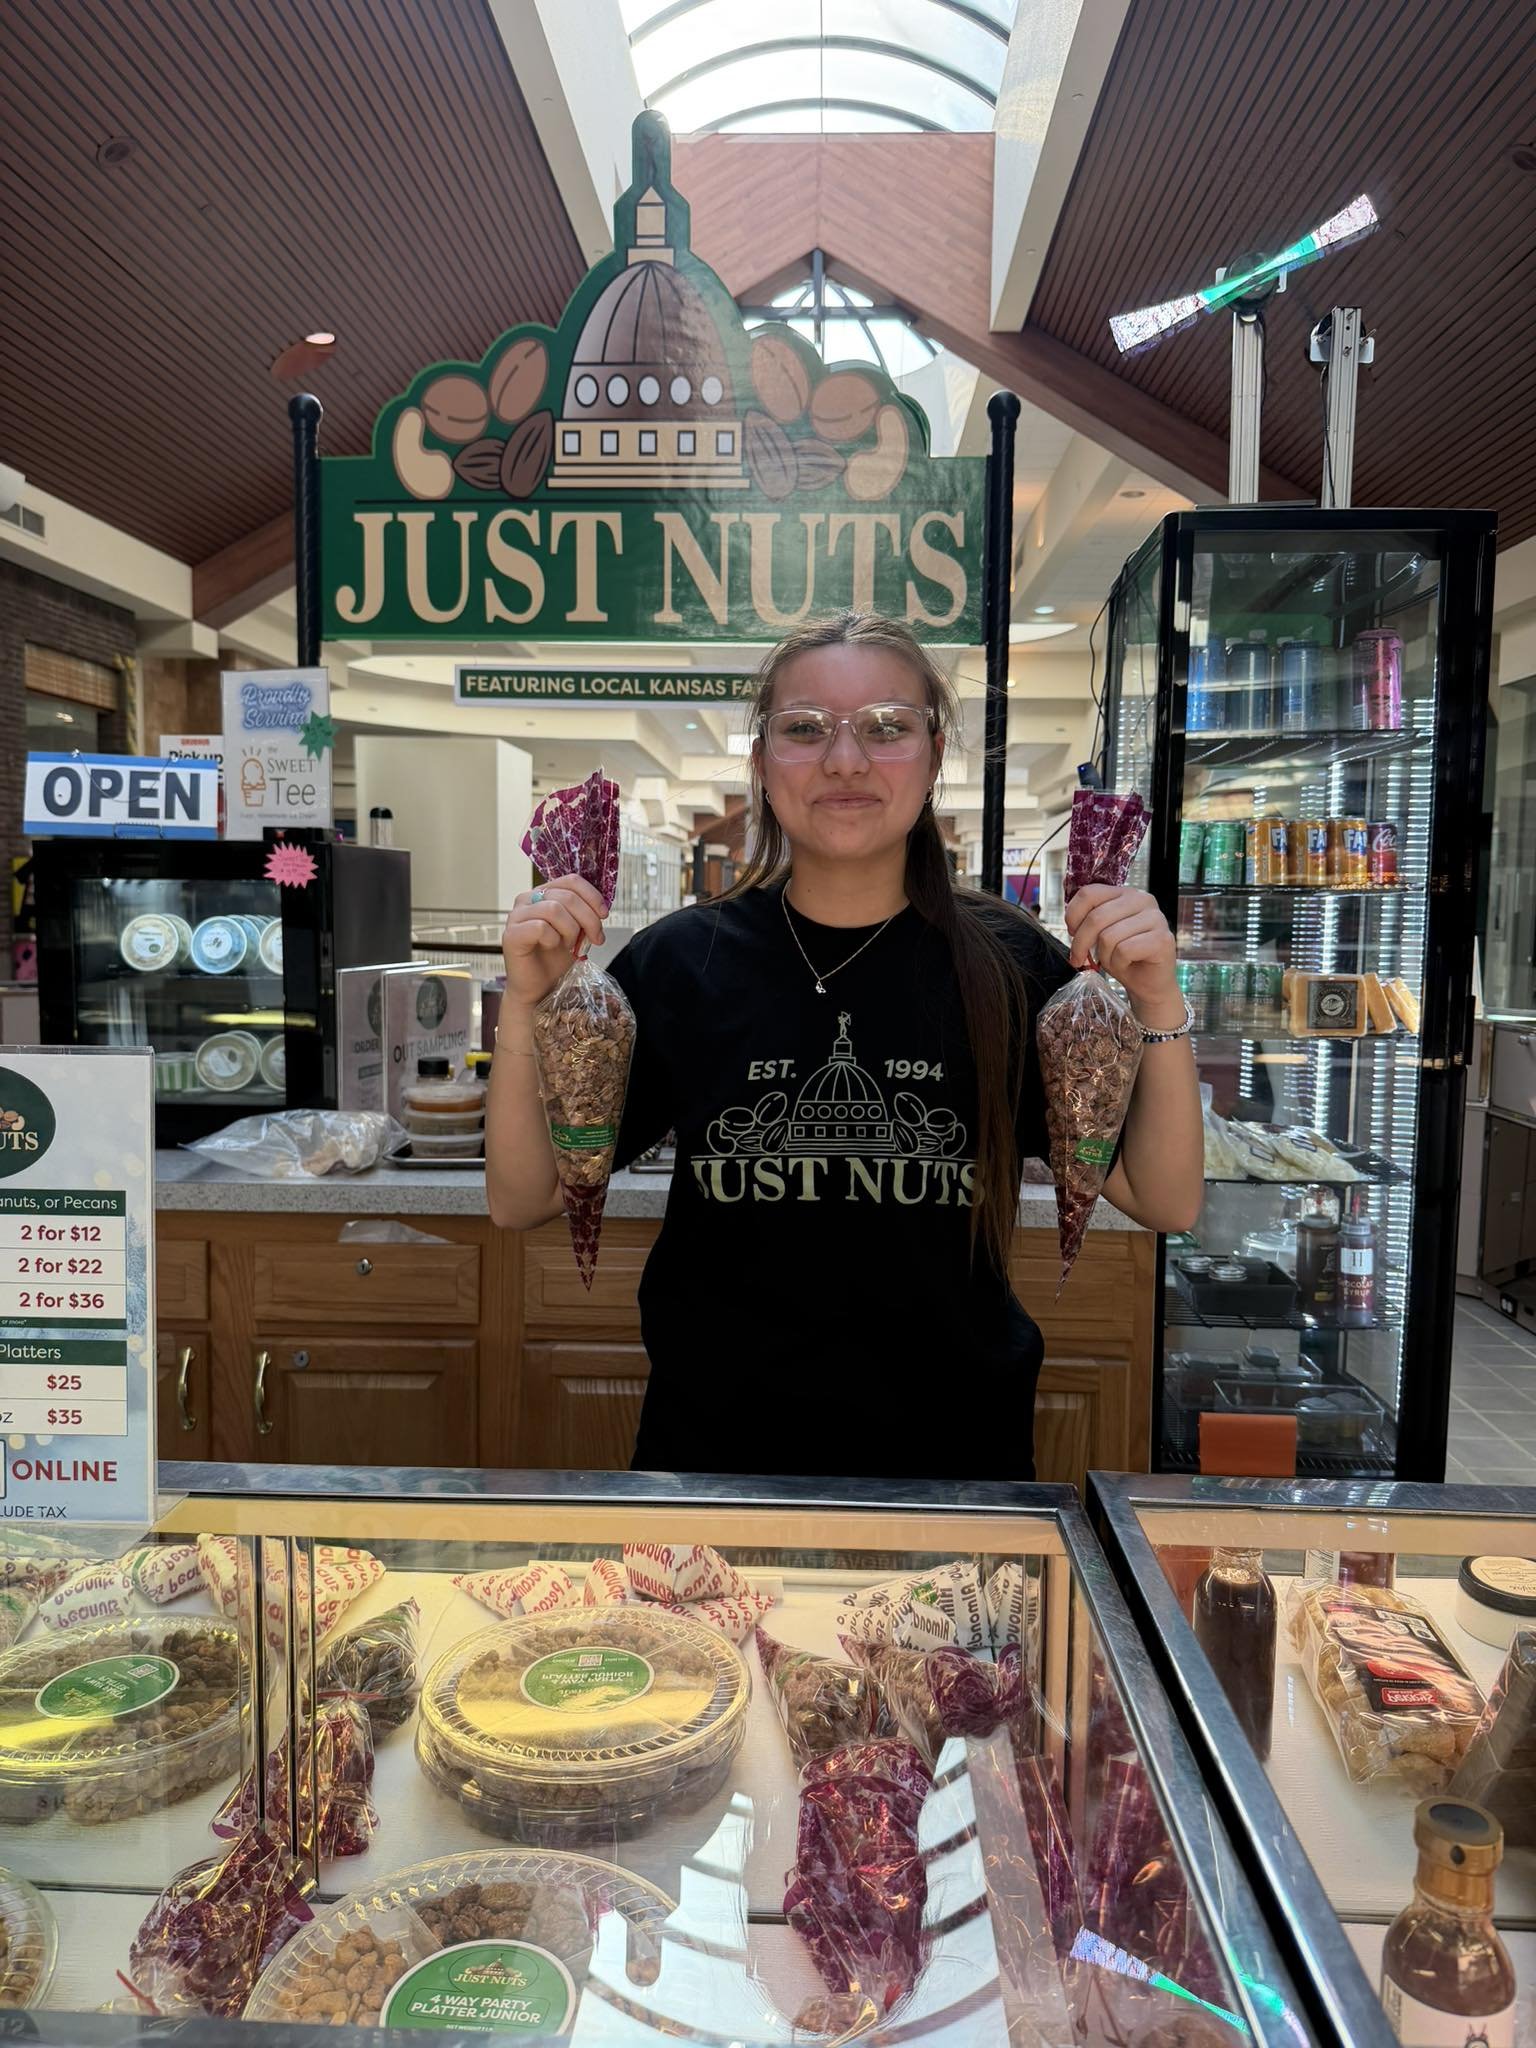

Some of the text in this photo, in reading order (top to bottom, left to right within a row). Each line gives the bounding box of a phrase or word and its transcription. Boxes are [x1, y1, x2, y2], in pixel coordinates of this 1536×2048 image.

[335, 509, 969, 628] JUST NUTS
[241, 683, 310, 709] Proudly
[466, 675, 576, 695] FEATURING
[580, 677, 645, 696] LOCAL
[649, 678, 727, 697] KANSAS
[268, 759, 316, 773] SWEET
[43, 766, 201, 821] OPEN
[269, 777, 316, 806] Tee
[394, 1031, 466, 1063] OUT SAMPLING!
[747, 1059, 798, 1081] EST.
[884, 1058, 945, 1082] 1994
[845, 1157, 984, 1207] NUTS
[44, 1198, 60, 1208] or
[64, 1196, 118, 1210] Pecans
[20, 1224, 101, 1243] 2 for $12
[18, 1257, 103, 1276] 2 for $22
[19, 1291, 104, 1310] 2 for $36
[47, 1374, 82, 1391] $25
[47, 1408, 83, 1426] $35
[12, 1459, 118, 1482] ONLINE
[38, 1506, 67, 1519] TAX
[454, 1974, 528, 1987] JUST NUTS
[411, 2002, 541, 2024] PLATTER JUNIOR
[429, 1994, 532, 2011] 4 WAY PARTY
